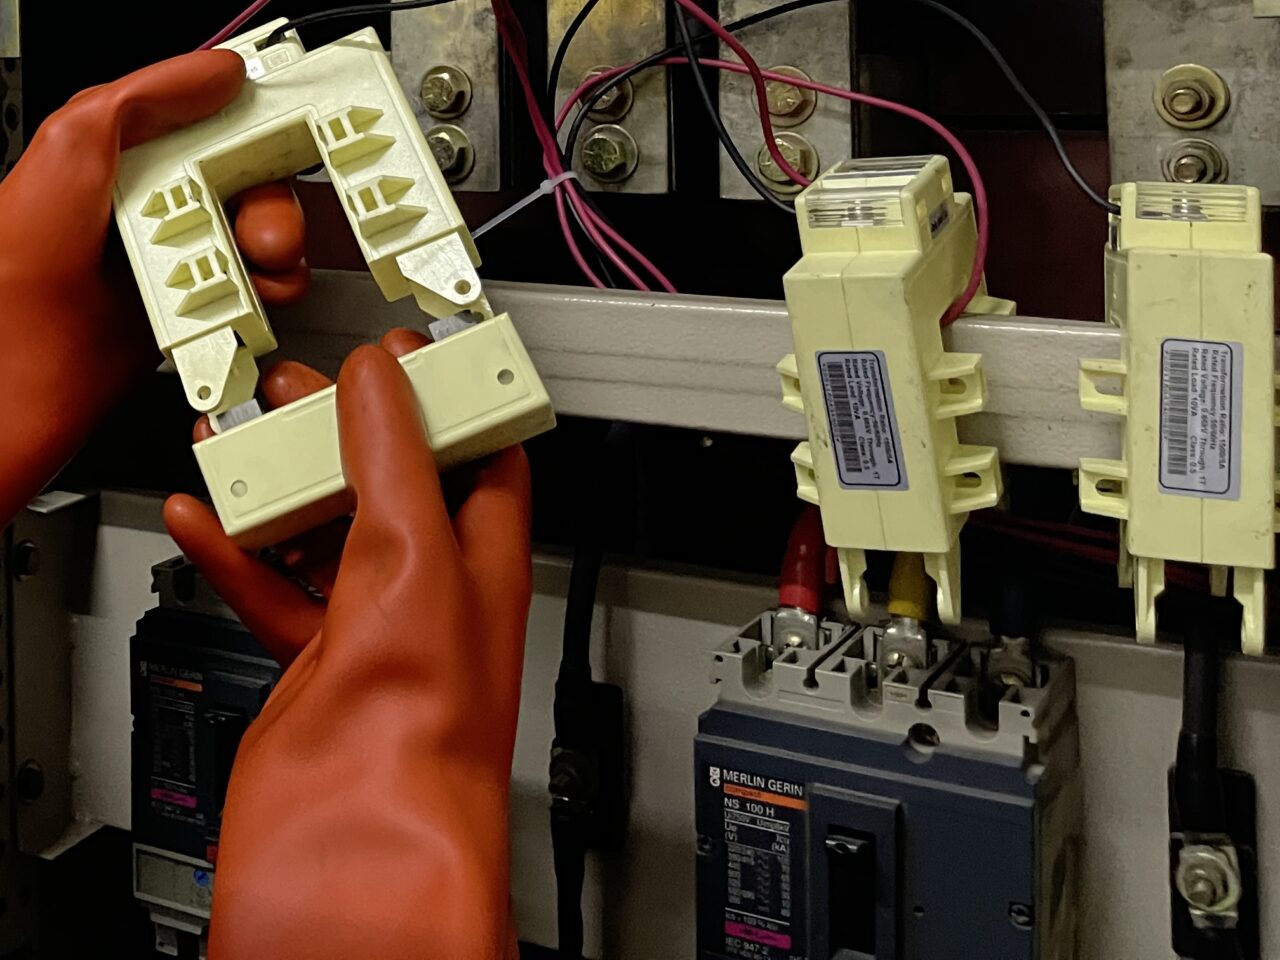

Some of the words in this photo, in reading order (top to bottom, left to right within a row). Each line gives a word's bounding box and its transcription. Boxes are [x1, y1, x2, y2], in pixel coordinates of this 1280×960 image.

[861, 359, 869, 379] Rated
[1191, 397, 1199, 416] 10VA
[723, 769, 765, 788] MERLIN
[768, 780, 803, 796] GERIN
[724, 798, 739, 809] NS
[746, 803, 763, 815] 100
[766, 808, 774, 817] H
